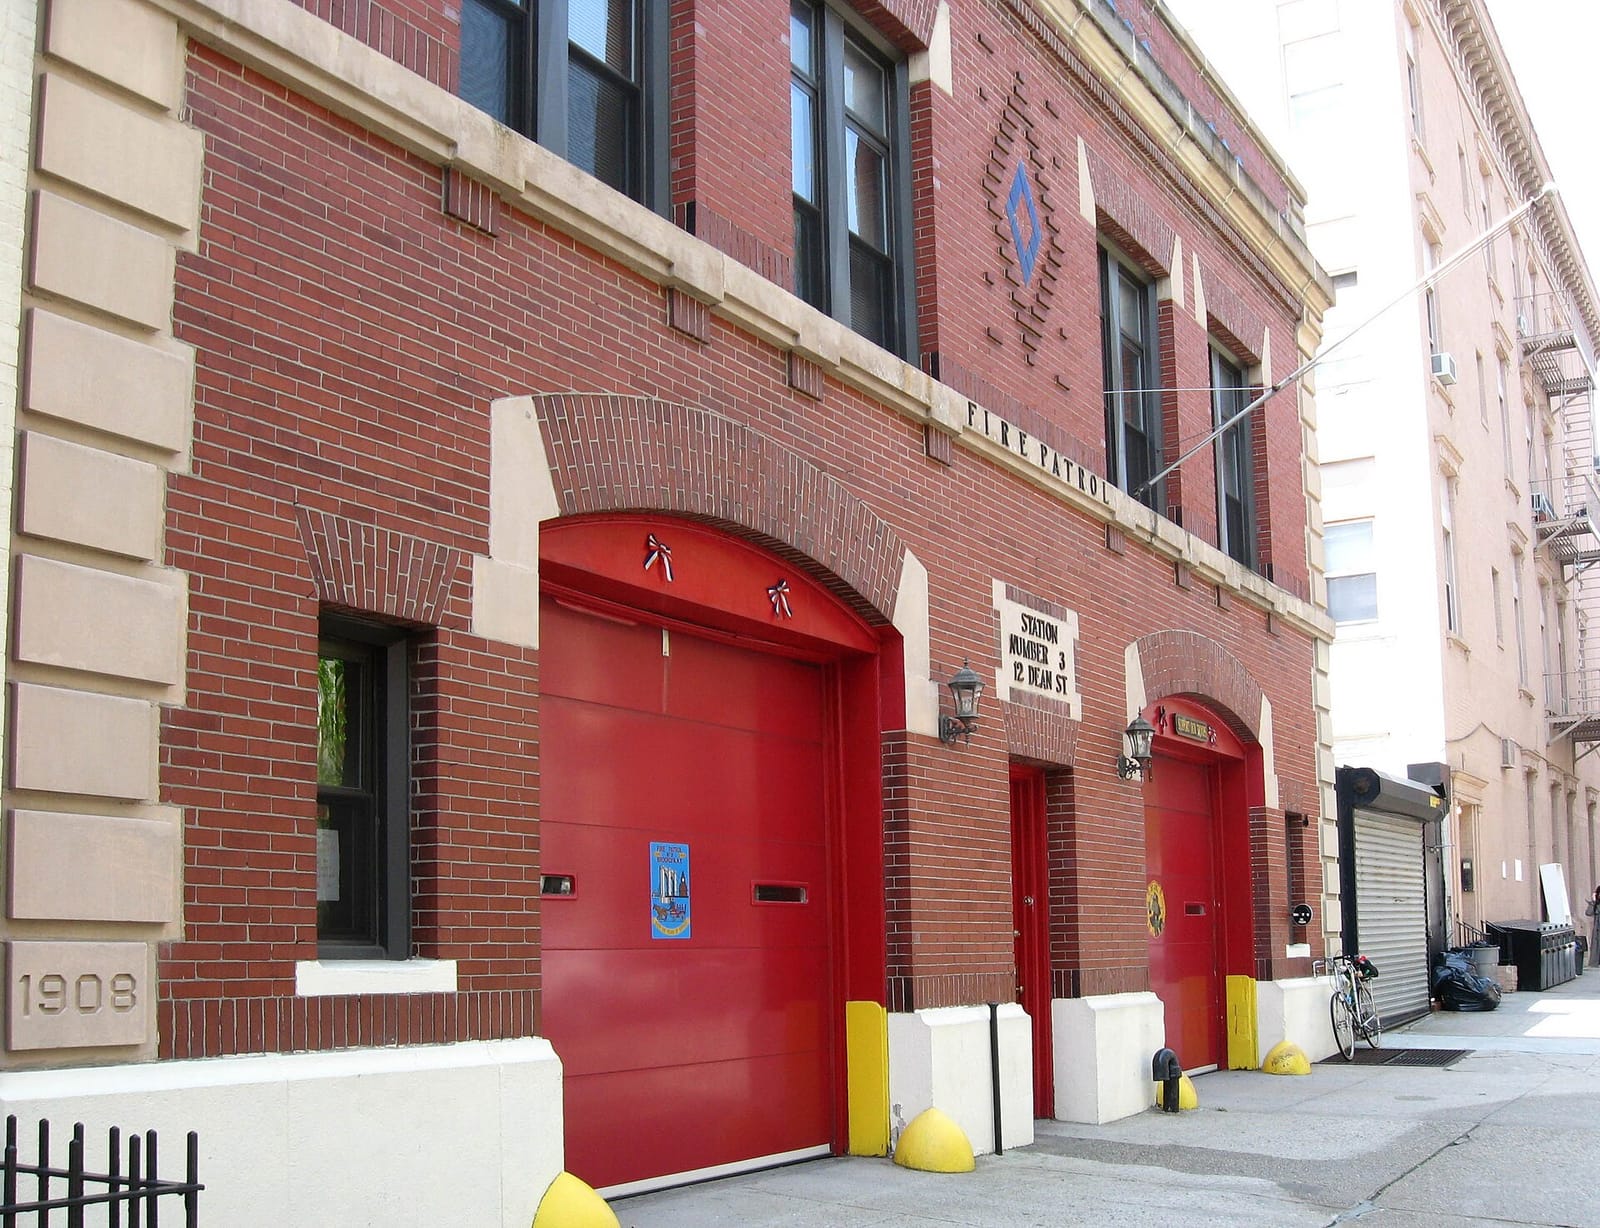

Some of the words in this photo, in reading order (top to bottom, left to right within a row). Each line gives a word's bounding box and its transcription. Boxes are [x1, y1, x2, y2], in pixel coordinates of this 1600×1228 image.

[967, 401, 1027, 457] FIRE
[1040, 443, 1110, 505] PATROL
[1021, 612, 1058, 645] STATION
[1009, 633, 1049, 665] NUMBER
[1058, 651, 1066, 671] 3
[1013, 661, 1025, 683] 12
[1028, 665, 1053, 691] DEAN
[1056, 674, 1068, 696] ST
[19, 973, 136, 1017] 1908
